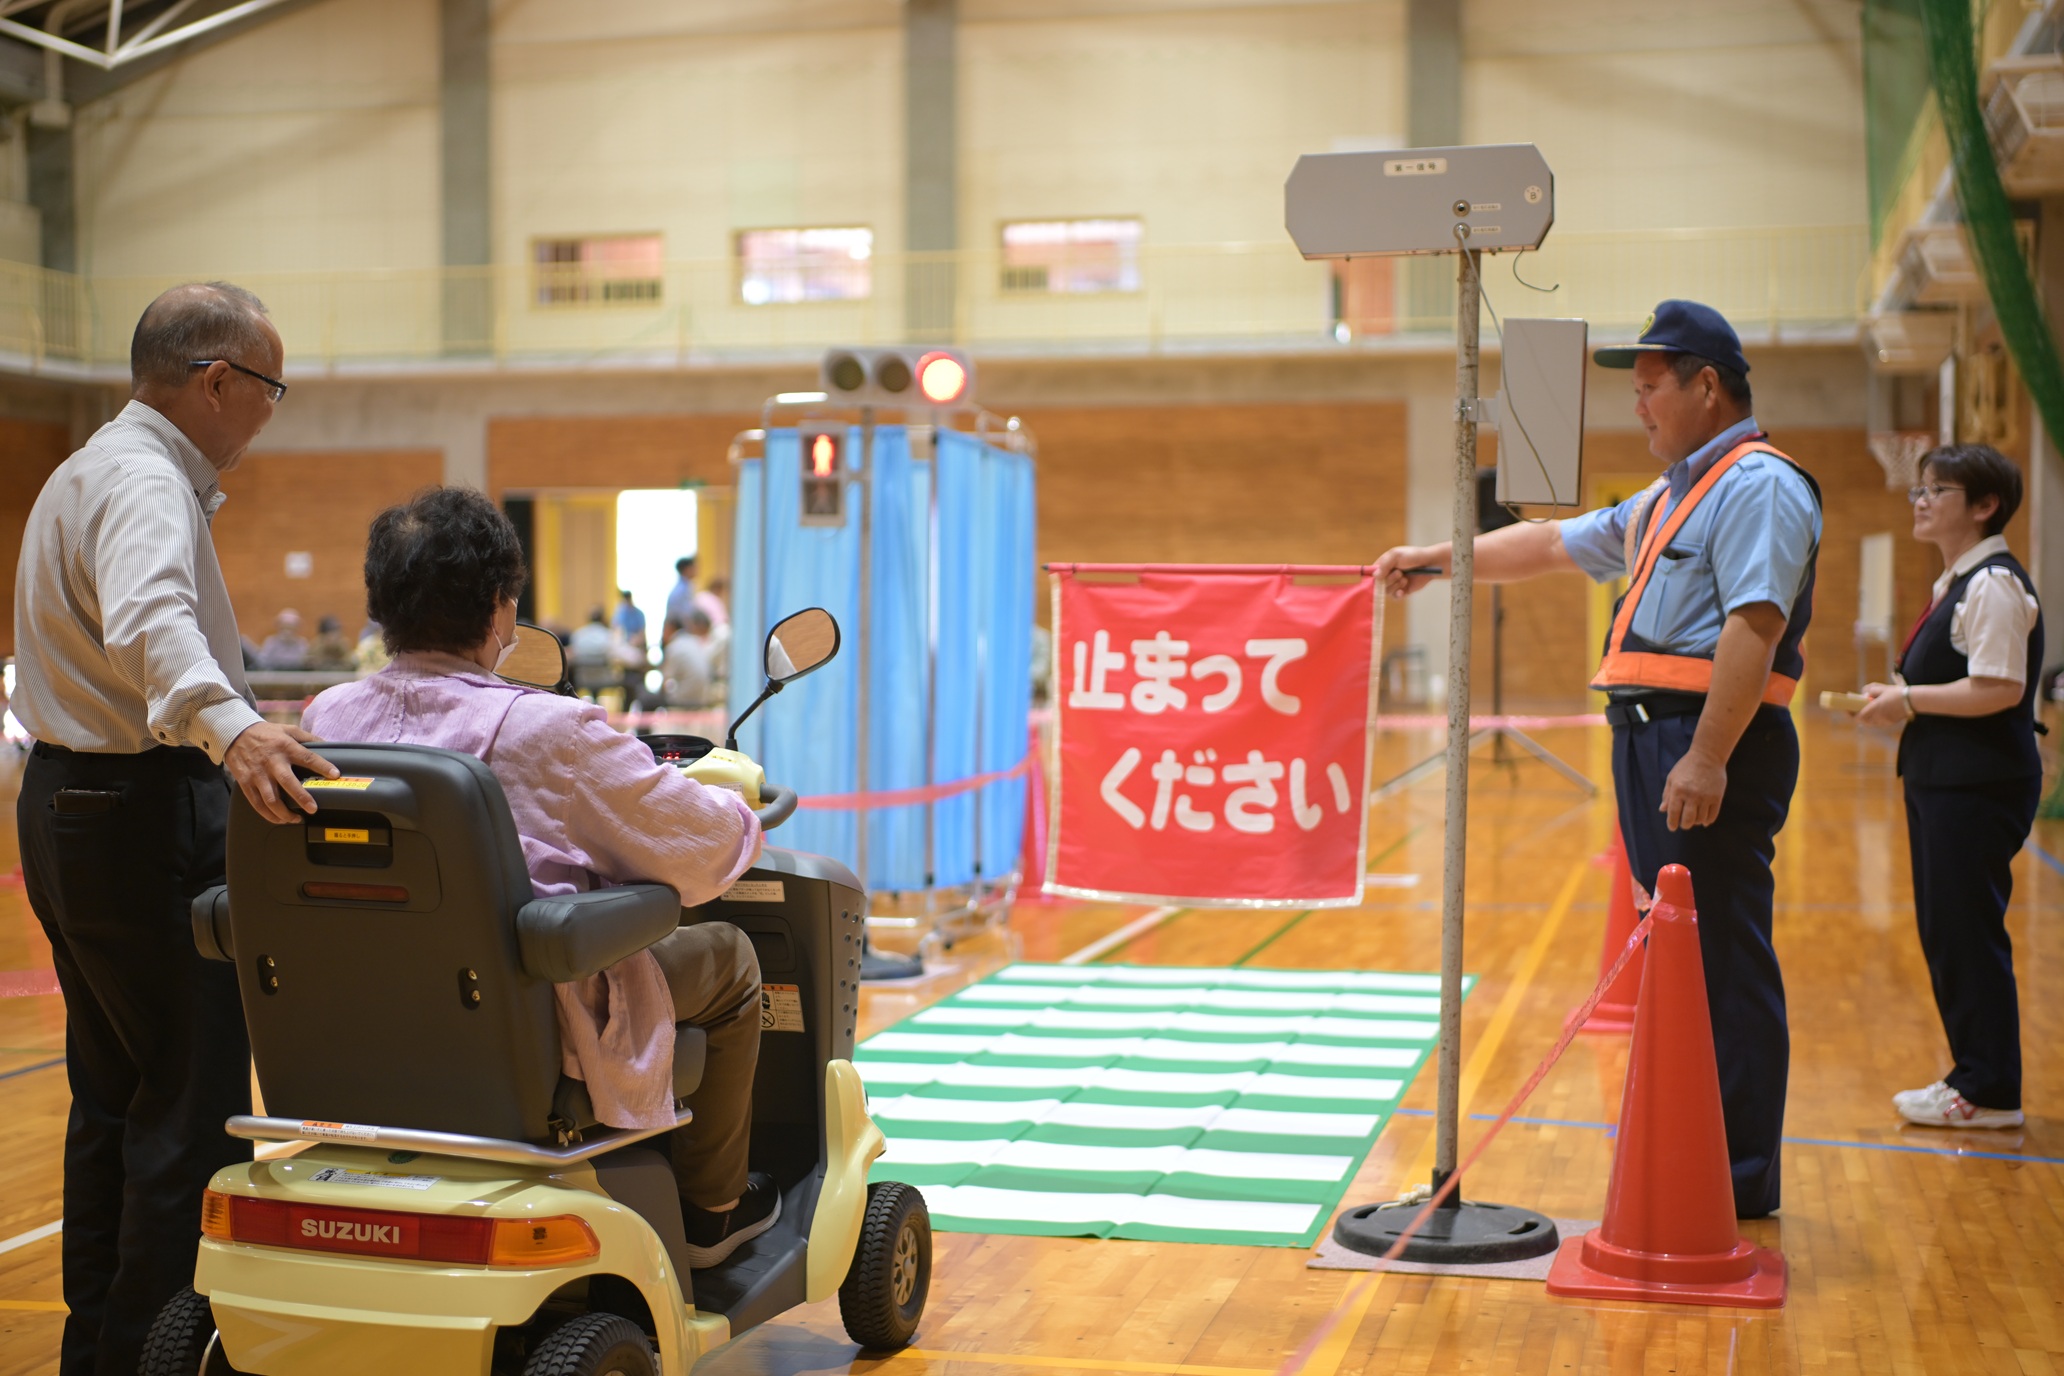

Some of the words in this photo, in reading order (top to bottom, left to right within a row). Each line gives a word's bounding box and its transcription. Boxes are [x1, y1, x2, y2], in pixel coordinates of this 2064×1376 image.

[1068, 629, 1308, 716] 止まって
[1100, 747, 1351, 834] ください
[301, 1219, 400, 1244] SUZUKI
